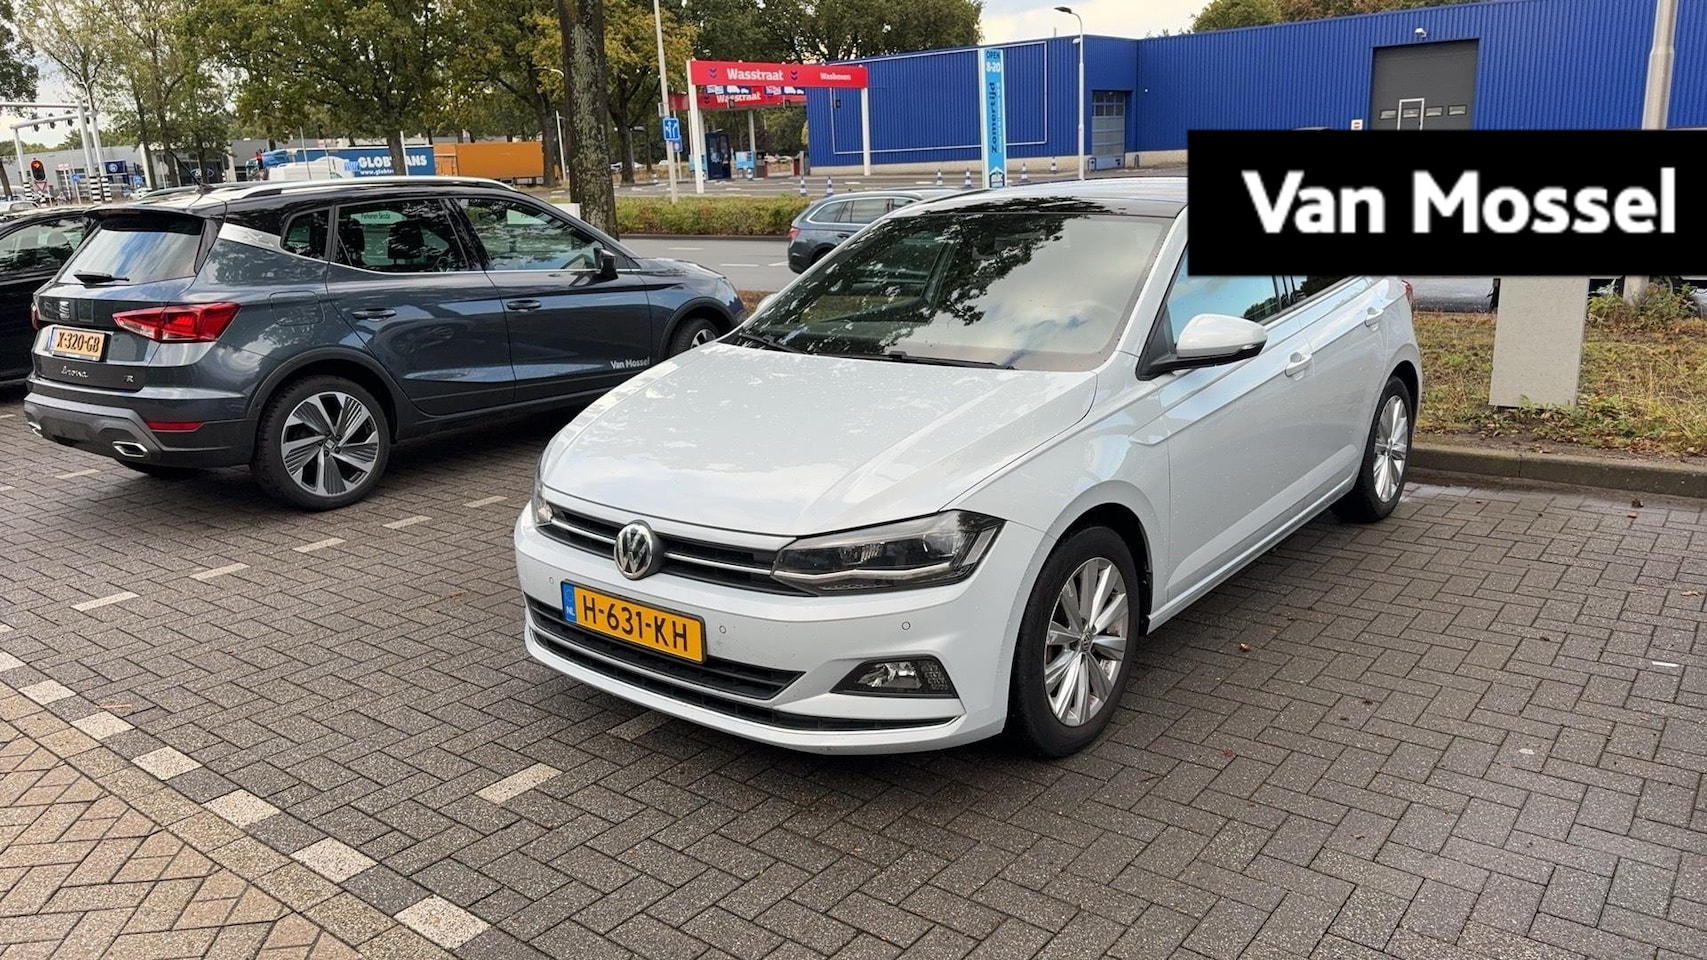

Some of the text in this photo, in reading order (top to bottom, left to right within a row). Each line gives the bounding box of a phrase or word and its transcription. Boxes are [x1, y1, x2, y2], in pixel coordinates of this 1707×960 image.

[726, 67, 784, 81] Wasstraat
[989, 82, 997, 154] Zomertijd
[359, 154, 428, 168] GLOBANS
[56, 331, 101, 353] X-320-GB
[610, 356, 650, 369] Van Mossel
[566, 605, 575, 617] NL
[582, 594, 689, 653] H-631-KH
